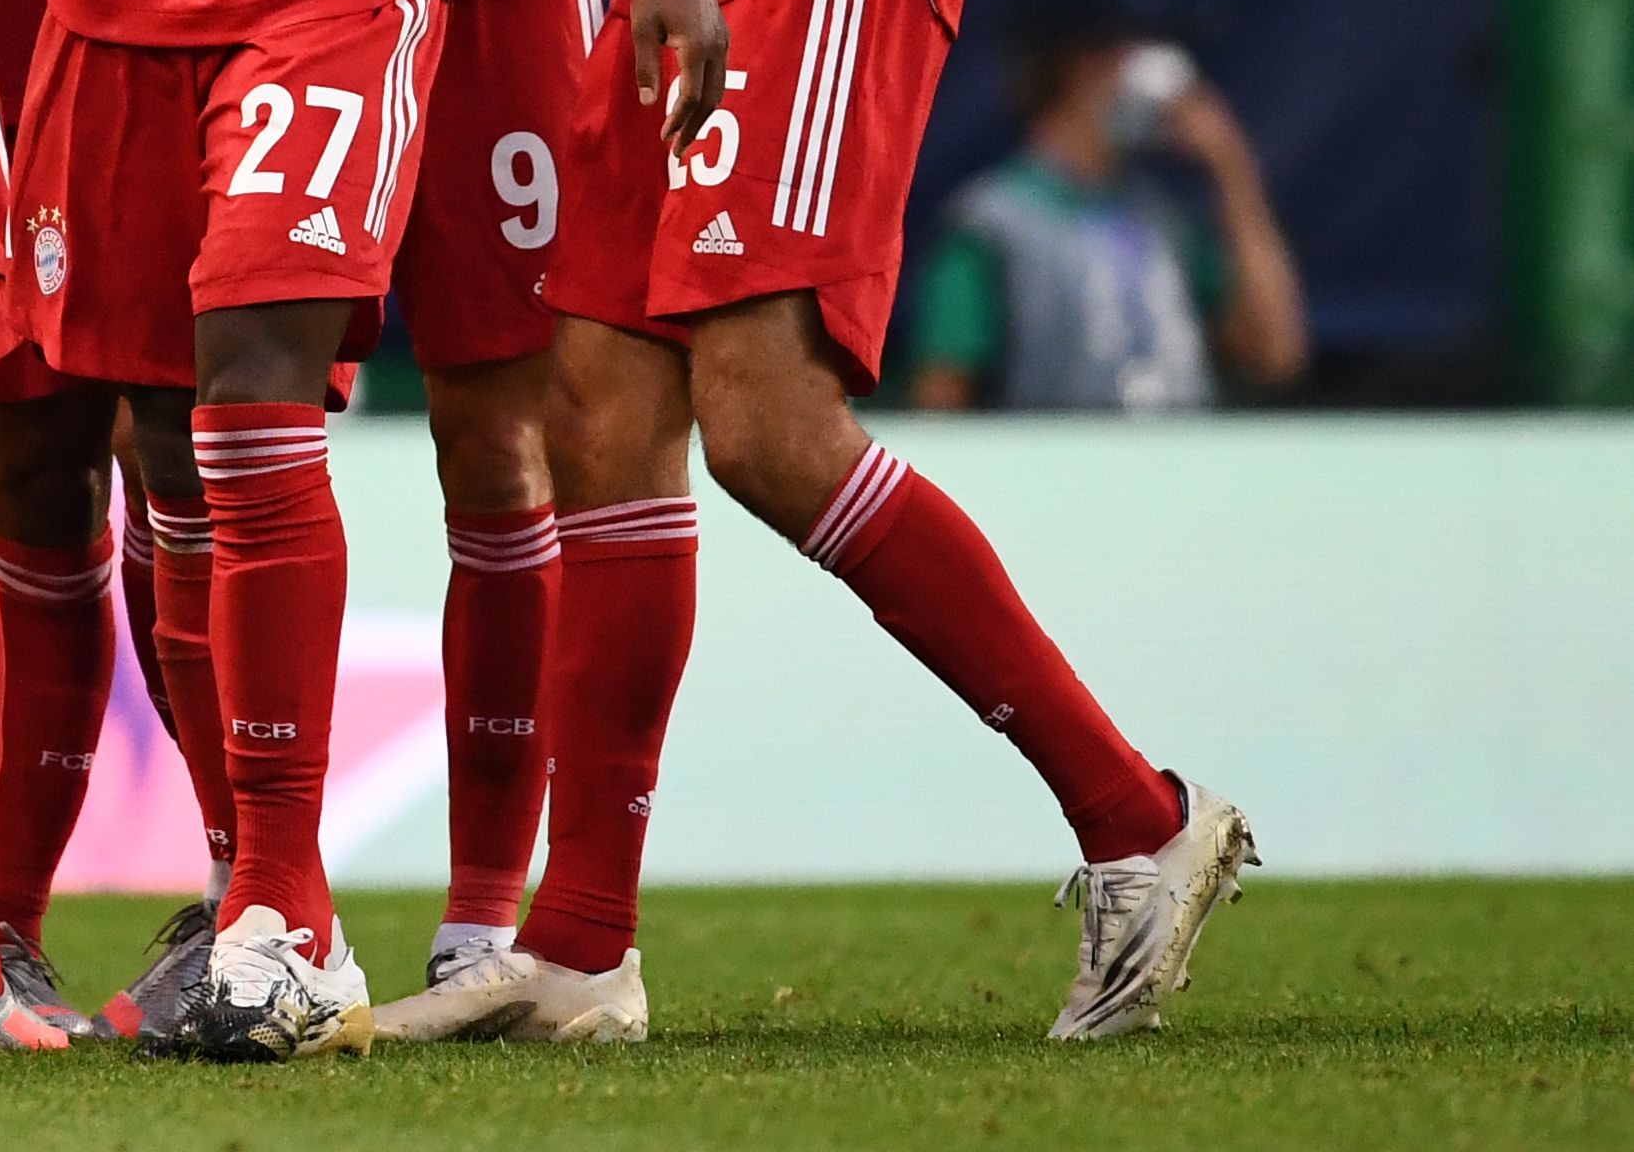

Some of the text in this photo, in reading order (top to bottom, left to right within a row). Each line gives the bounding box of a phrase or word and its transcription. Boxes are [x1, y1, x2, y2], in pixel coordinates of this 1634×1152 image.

[226, 82, 365, 200] 27
[490, 130, 560, 250] 9
[288, 227, 347, 256] adidas
[692, 237, 745, 256] adidas
[231, 718, 298, 740] FCB
[468, 716, 536, 736] FCB
